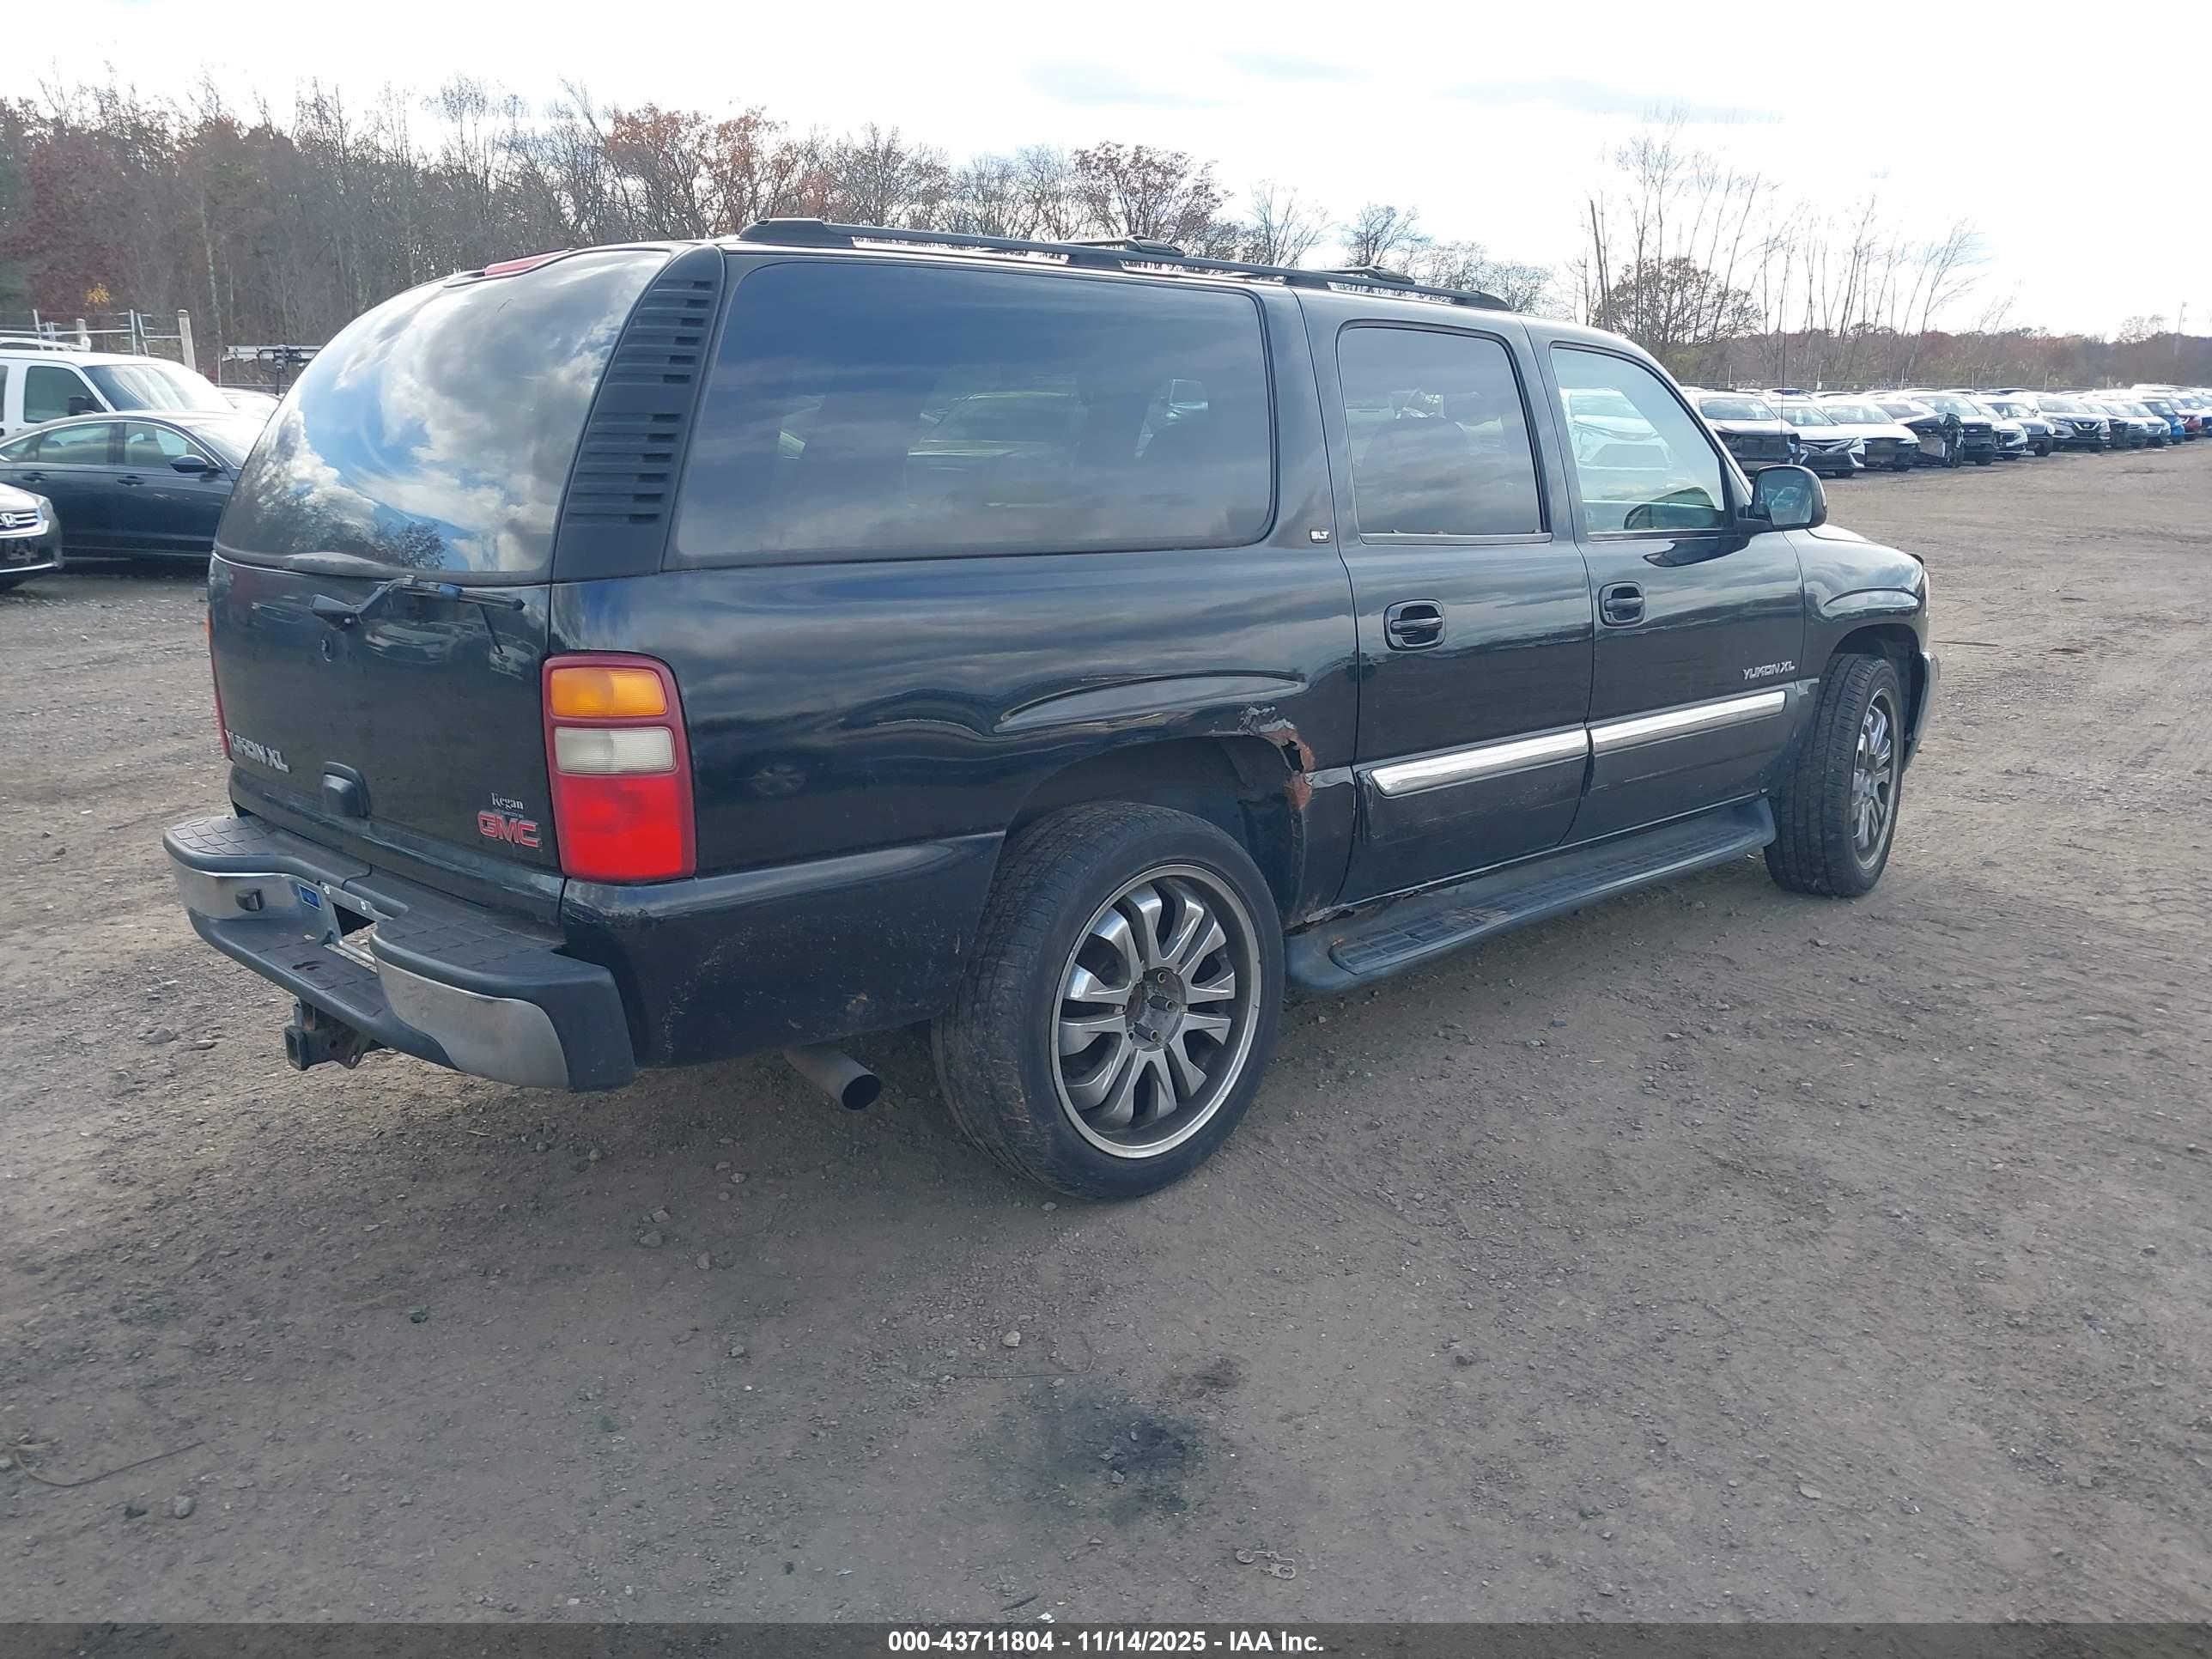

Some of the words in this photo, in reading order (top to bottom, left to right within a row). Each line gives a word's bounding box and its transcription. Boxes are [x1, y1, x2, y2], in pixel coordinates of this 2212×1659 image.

[1742, 664, 1780, 680] YUKON
[1779, 660, 1796, 673] XL
[265, 747, 289, 773] XL
[477, 811, 543, 848] GMC
